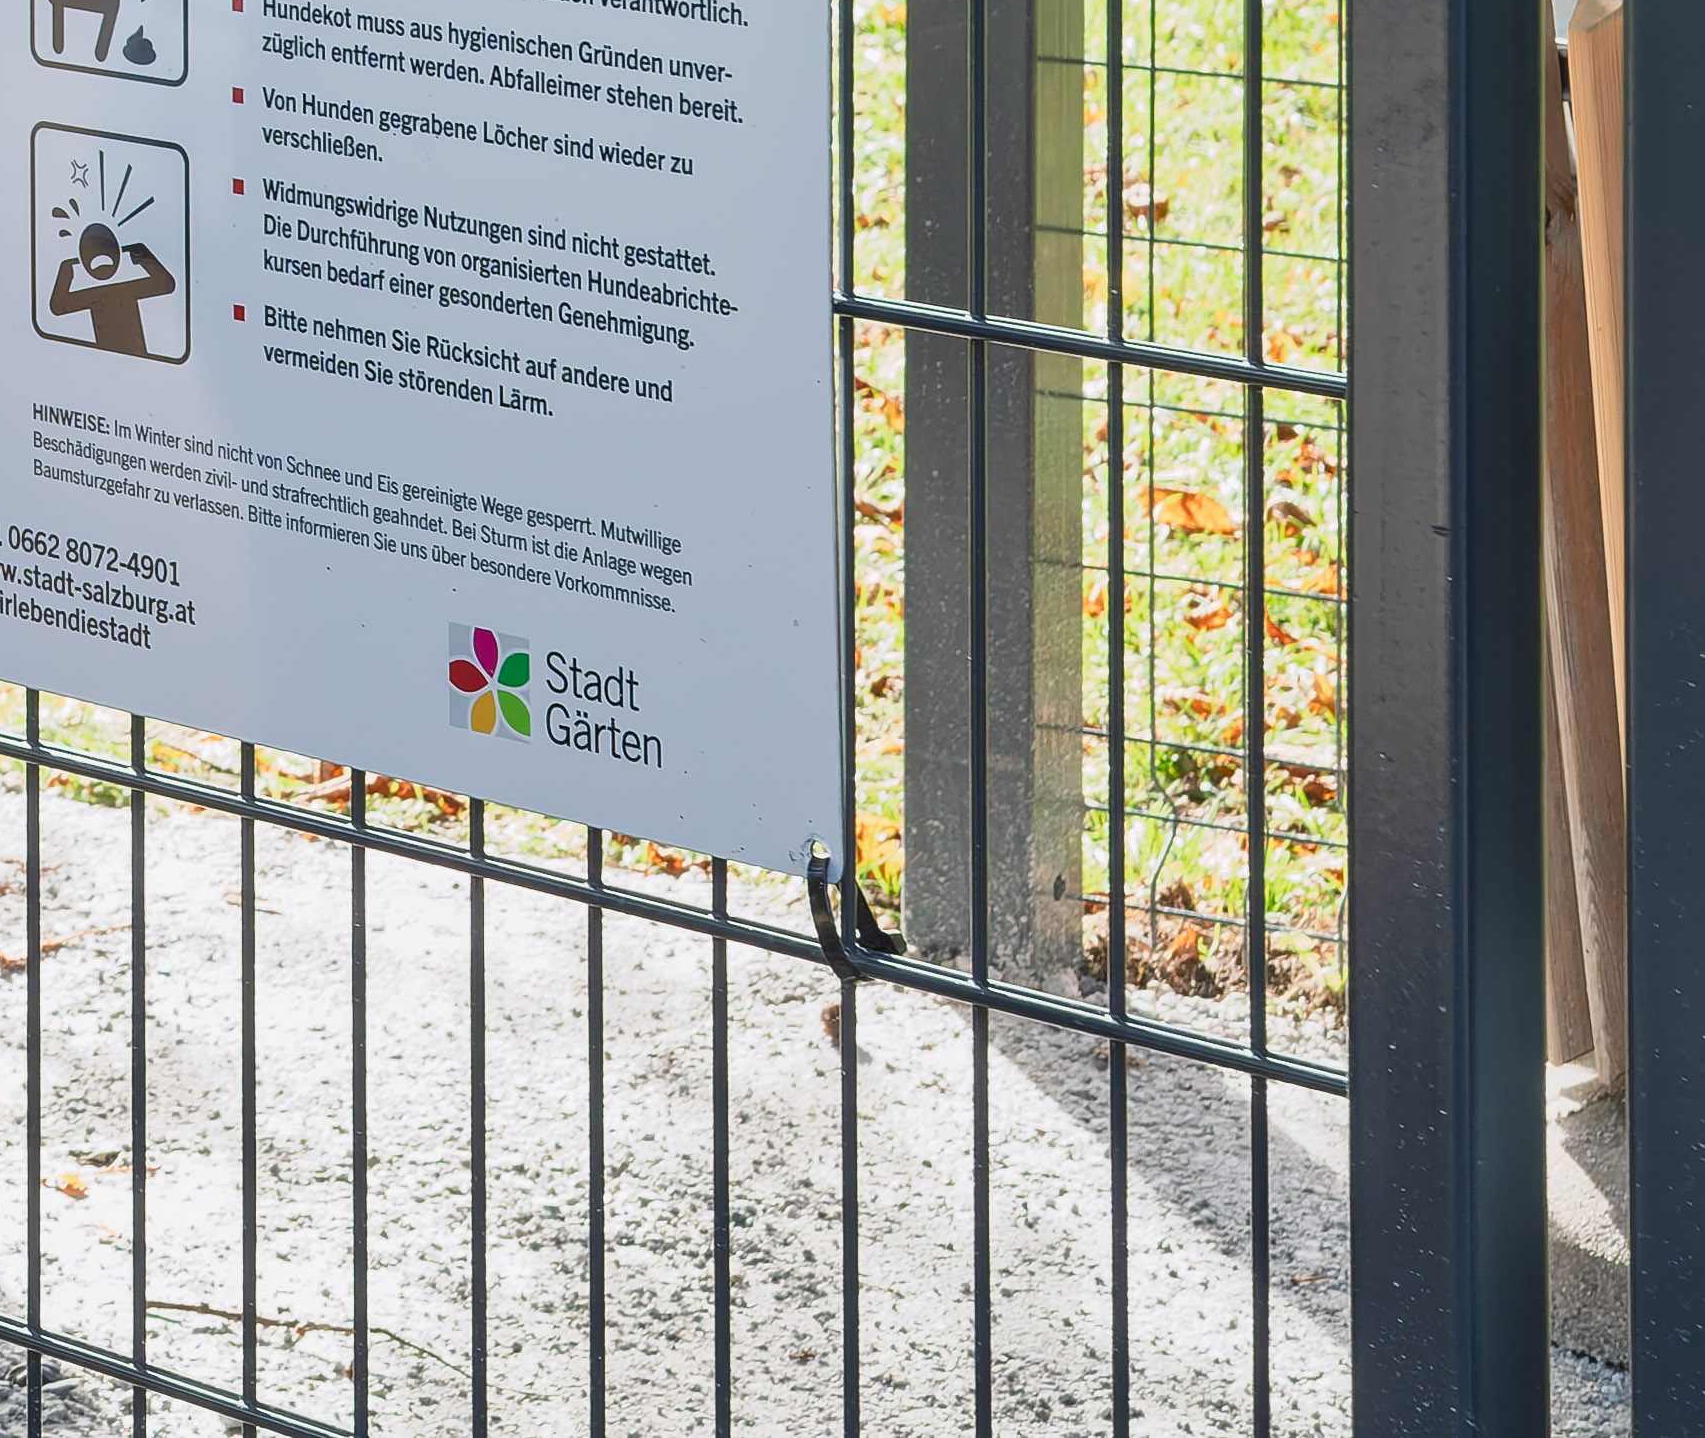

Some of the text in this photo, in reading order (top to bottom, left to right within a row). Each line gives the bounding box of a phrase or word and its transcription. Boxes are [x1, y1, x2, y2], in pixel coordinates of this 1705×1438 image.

[261, 31, 744, 125] züglich entfernt werden. Abfalleimer stehen bereit.
[356, 13, 406, 38] muss
[409, 21, 444, 43] aus
[447, 20, 574, 62] hygienischen
[578, 40, 664, 75] Gründen
[668, 58, 734, 84] unver-
[261, 86, 694, 176] Von Hunden gegrabene Löcher sind wieder zu
[261, 177, 716, 277] Widmungswidrige Nutzungen sind nicht gestattet.
[263, 212, 740, 317] Die Durchführung von organisierten Hundeabrichte-
[263, 247, 695, 352] kursen bedarf einer gesonderten Genehmigung.
[262, 344, 554, 417] vermeiden Sie störenden Lärm.
[263, 303, 674, 404] Bitte nehmen Sie Rücksicht auf andere und
[32, 401, 683, 557] HINWEISE: Im Winter sind nicht von Schnee und Eis gereinigte Wege gesperrt. Mutwillige
[7, 524, 61, 560] 0662
[64, 537, 181, 588] 8072-4901
[32, 457, 677, 614] Baumsturzgefahr zu verlassen. Bitte informieren Sie uns über besondere Vorkommnisse.
[545, 650, 641, 713] Stadt
[545, 702, 663, 769] Gärten
